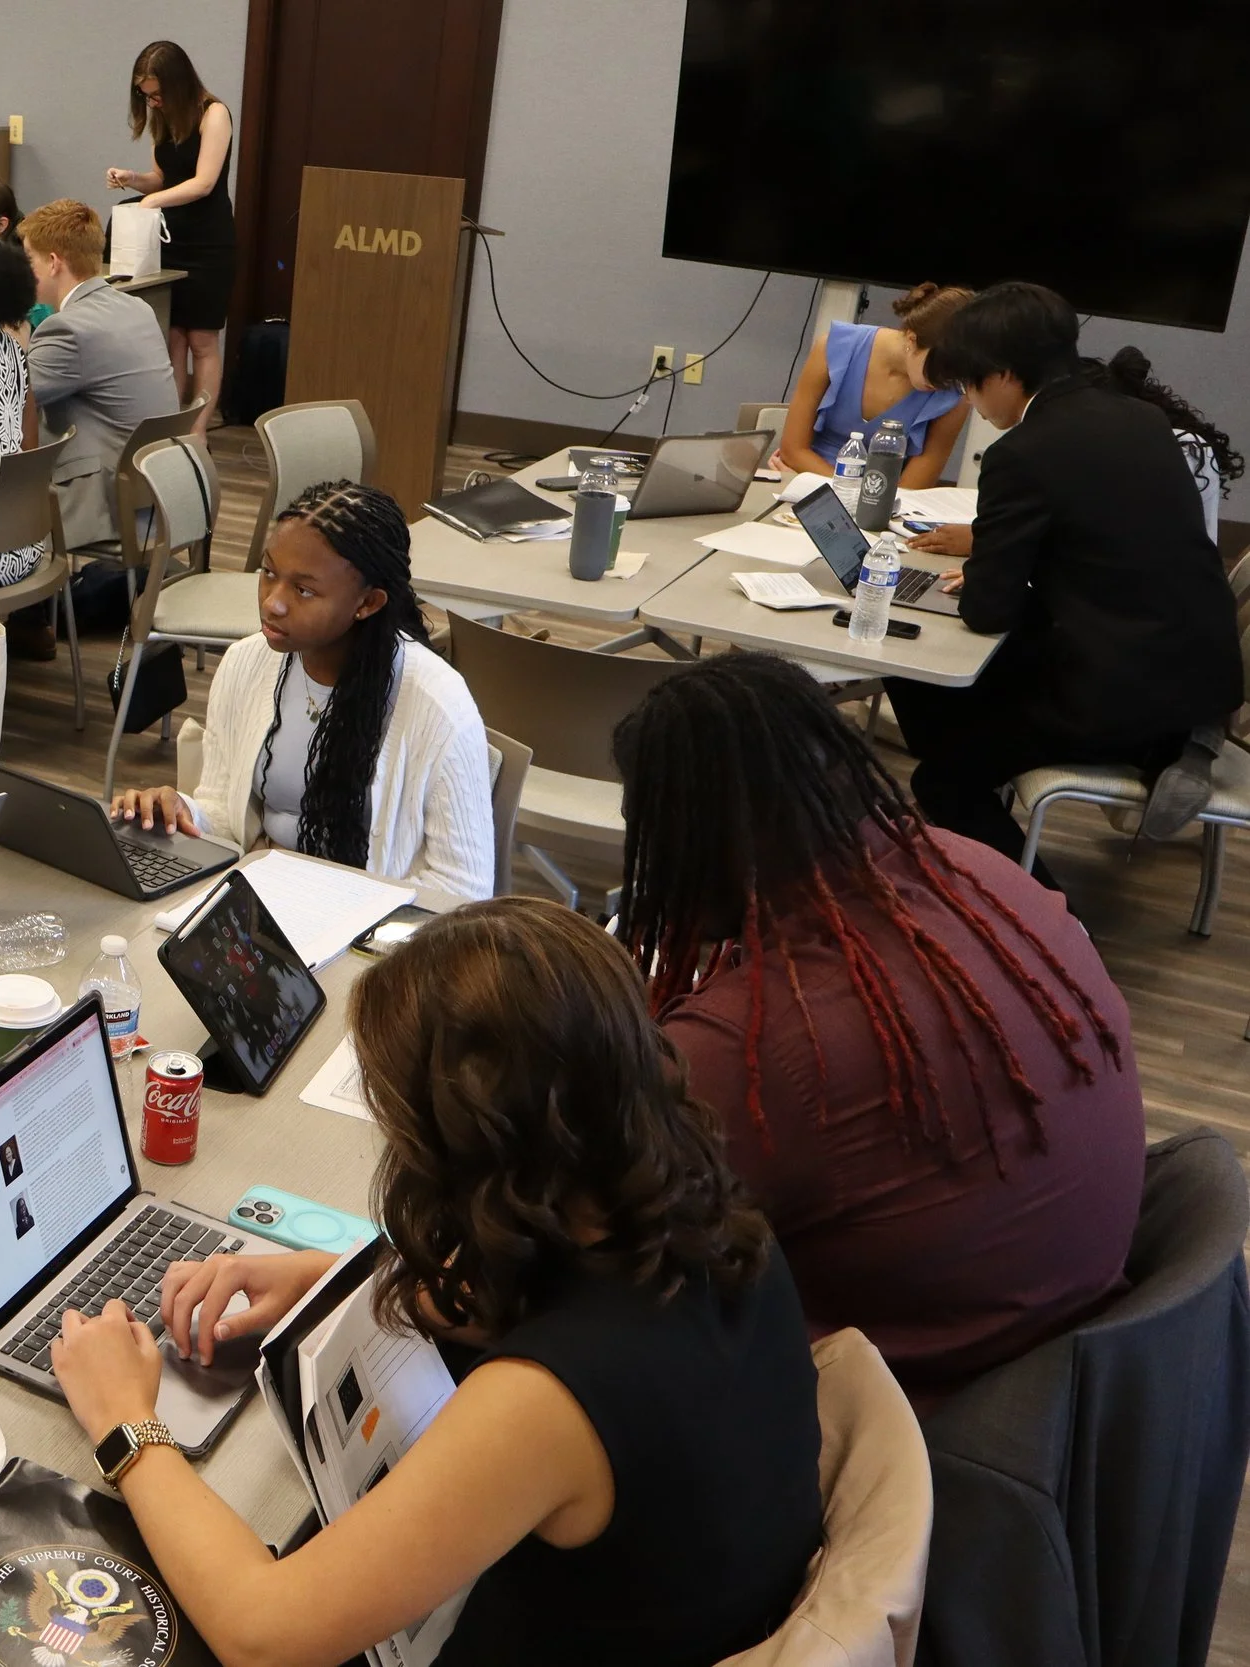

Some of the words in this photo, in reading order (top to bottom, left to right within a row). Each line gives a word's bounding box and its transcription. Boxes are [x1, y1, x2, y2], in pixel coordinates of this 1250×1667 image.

[334, 224, 422, 257] ALMD
[18, 1550, 86, 1566] SUPREME
[94, 1556, 142, 1583] COURT
[140, 1584, 169, 1654] HISTORICAL
